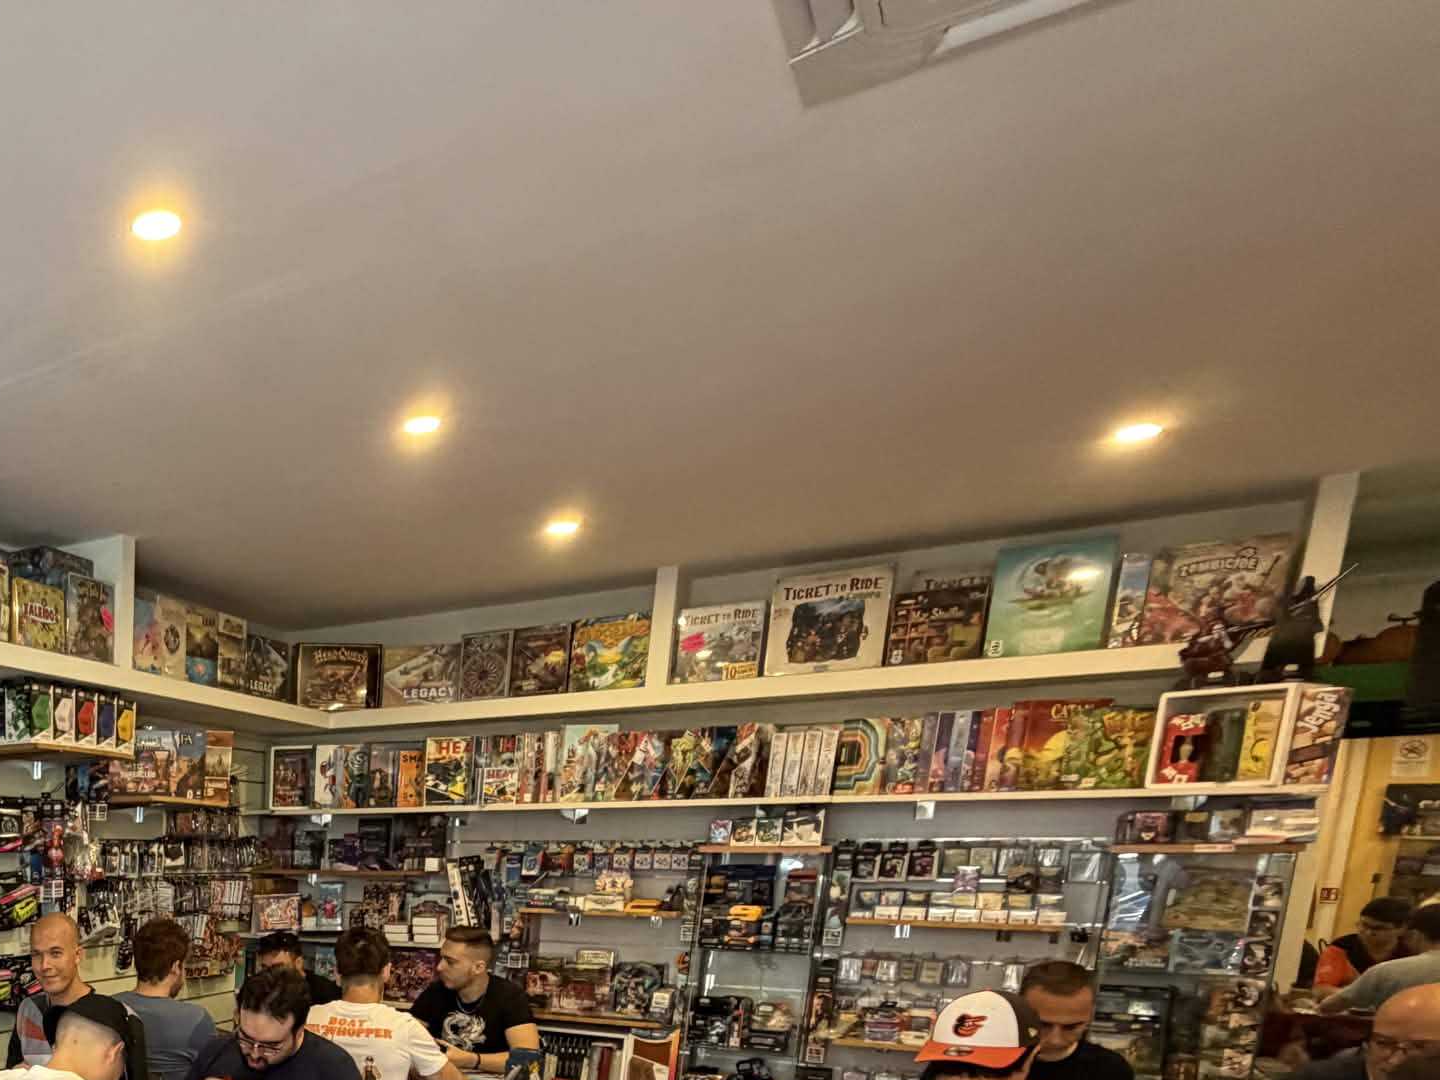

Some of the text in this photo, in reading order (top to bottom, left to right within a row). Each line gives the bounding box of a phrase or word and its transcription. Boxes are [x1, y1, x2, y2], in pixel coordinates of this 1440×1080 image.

[783, 584, 832, 601] TICKET
[850, 576, 885, 592] RIDE
[403, 687, 456, 700] LEGACY
[1296, 692, 1340, 733] Jenga
